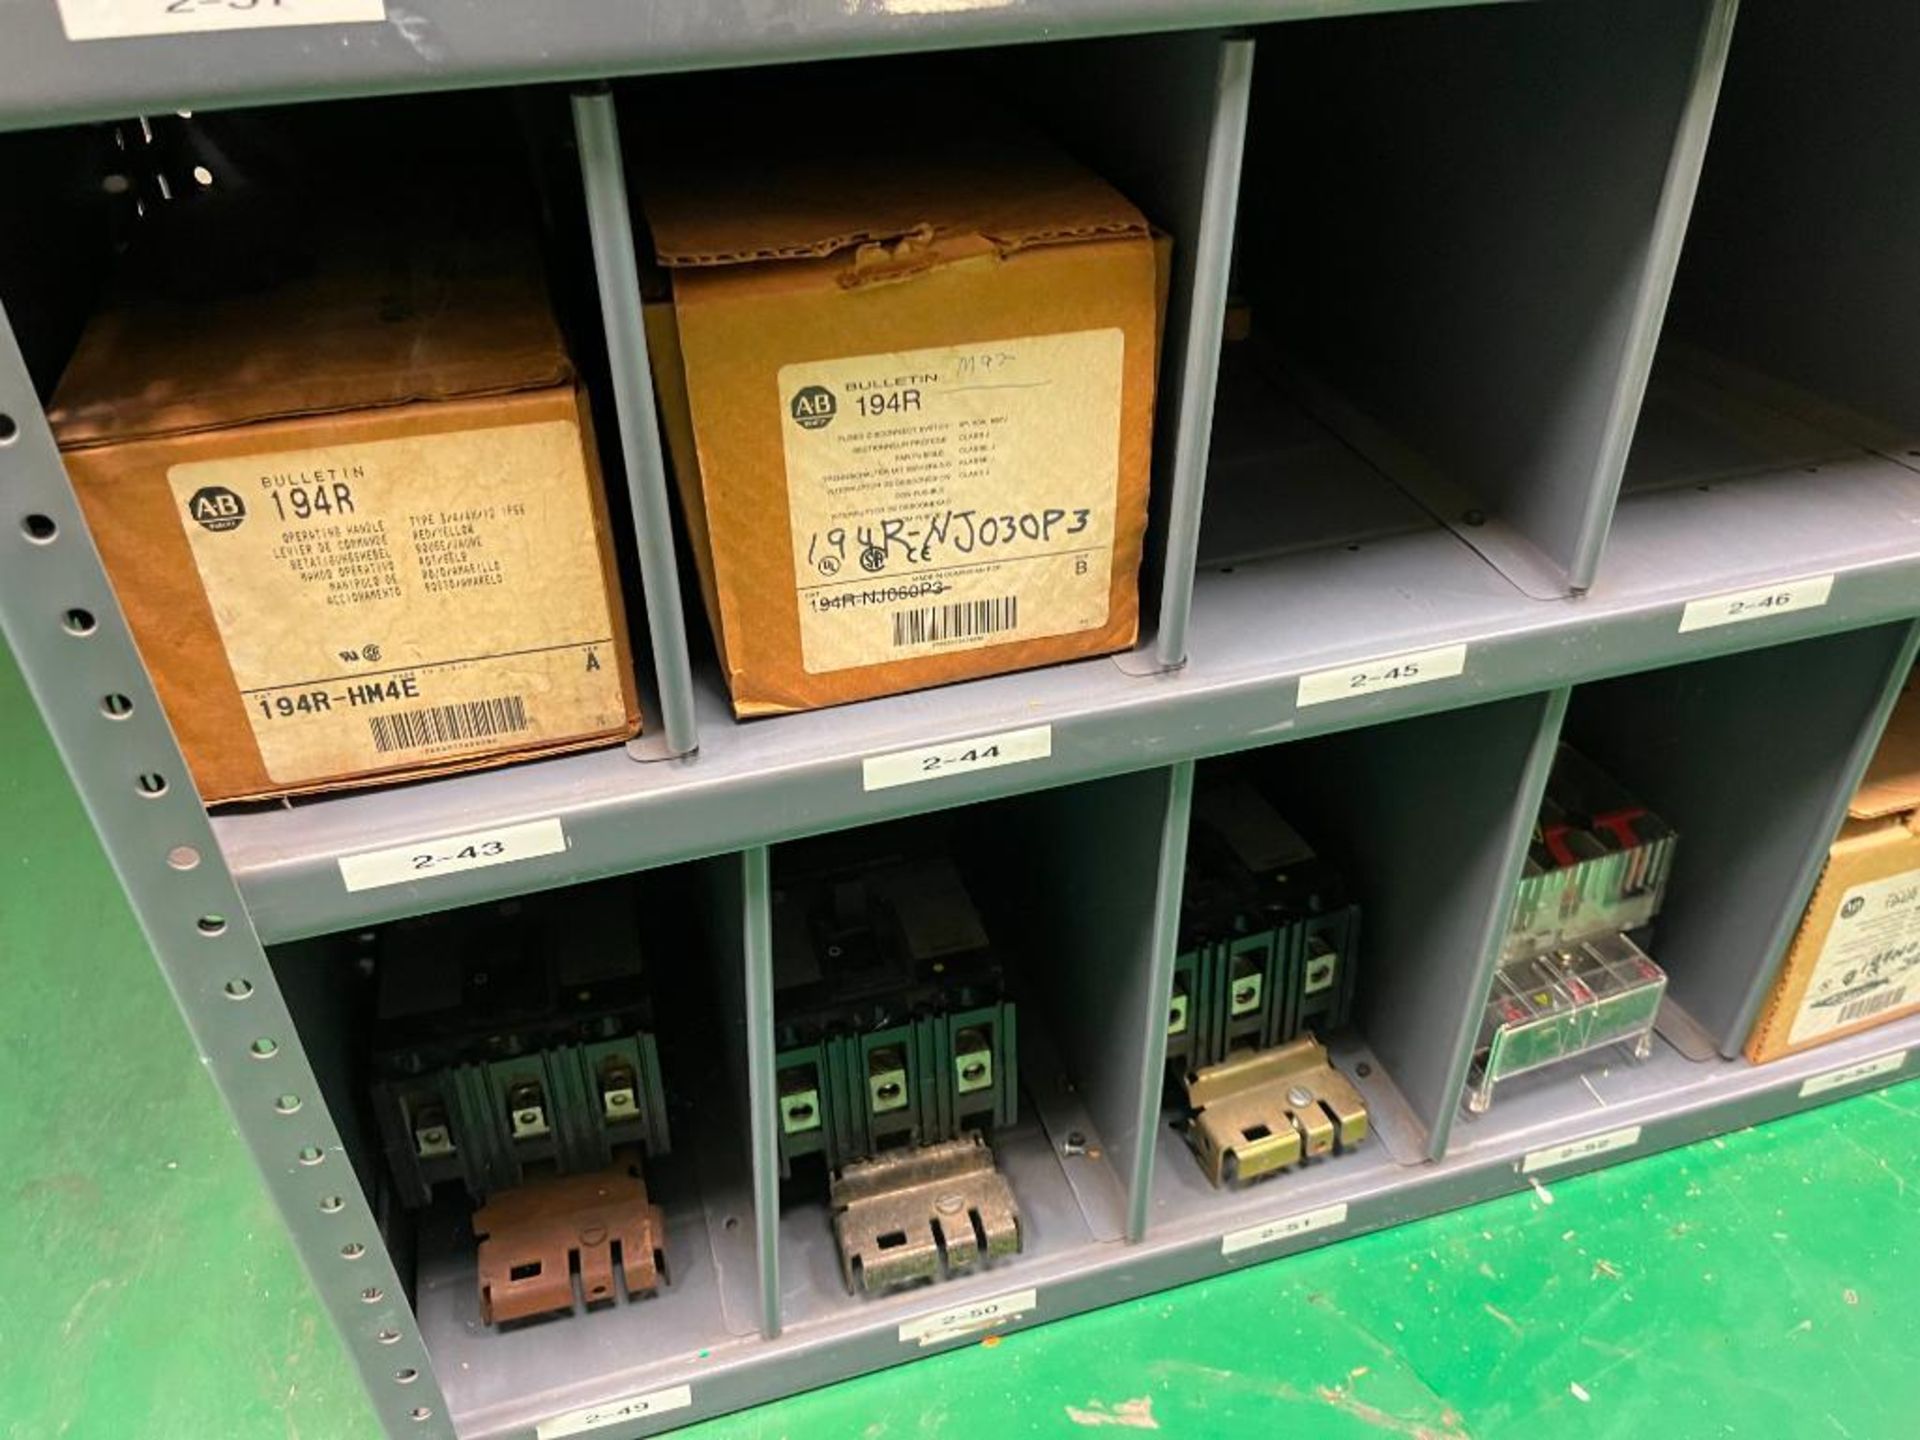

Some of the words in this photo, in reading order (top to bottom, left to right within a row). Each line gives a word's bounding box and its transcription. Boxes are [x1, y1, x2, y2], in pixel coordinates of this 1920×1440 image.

[845, 373, 938, 392] BULLETIN
[855, 388, 921, 417] 194R
[261, 465, 365, 489] BULLETIN
[271, 482, 355, 522] 194R
[409, 513, 436, 527] TYPE
[272, 543, 313, 560] LEVIER
[1075, 559, 1088, 577] B
[1727, 592, 1791, 616] 2-46
[585, 651, 601, 672] A
[1350, 662, 1420, 688] 2-45
[259, 676, 420, 720] 194R-HM4E
[922, 744, 1001, 771] 2-44
[411, 841, 505, 870] 2-43
